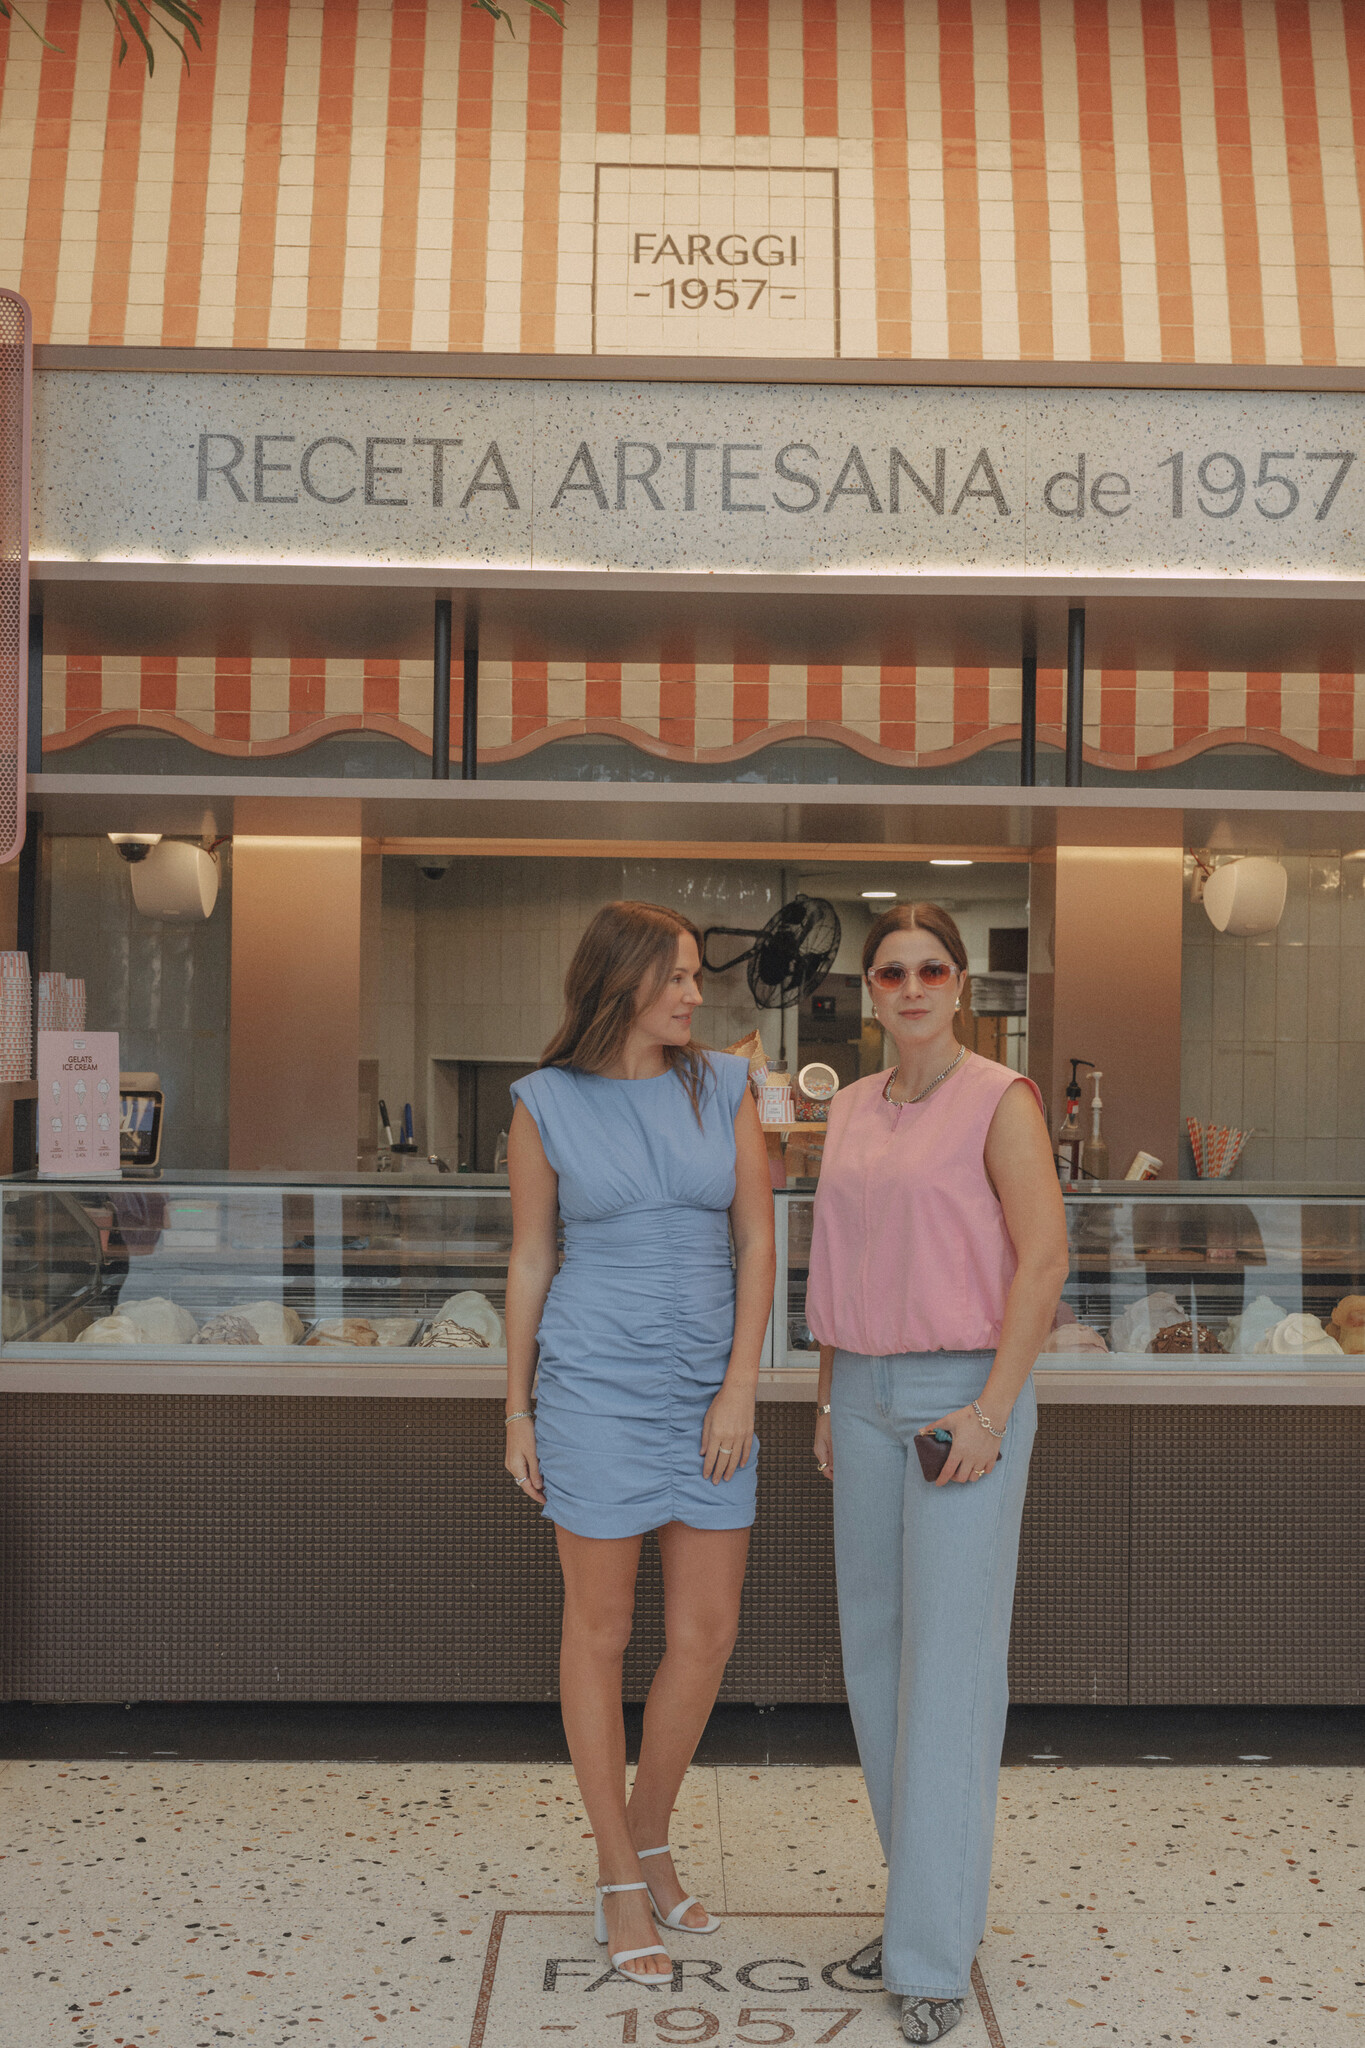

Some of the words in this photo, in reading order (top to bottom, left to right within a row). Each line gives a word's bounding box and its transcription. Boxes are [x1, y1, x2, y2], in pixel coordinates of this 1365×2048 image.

[633, 232, 797, 267] FARGGI
[198, 433, 520, 510] RECETA
[550, 440, 1011, 517] ARTESANA
[1043, 452, 1131, 518] de
[1157, 451, 1357, 520] 1957
